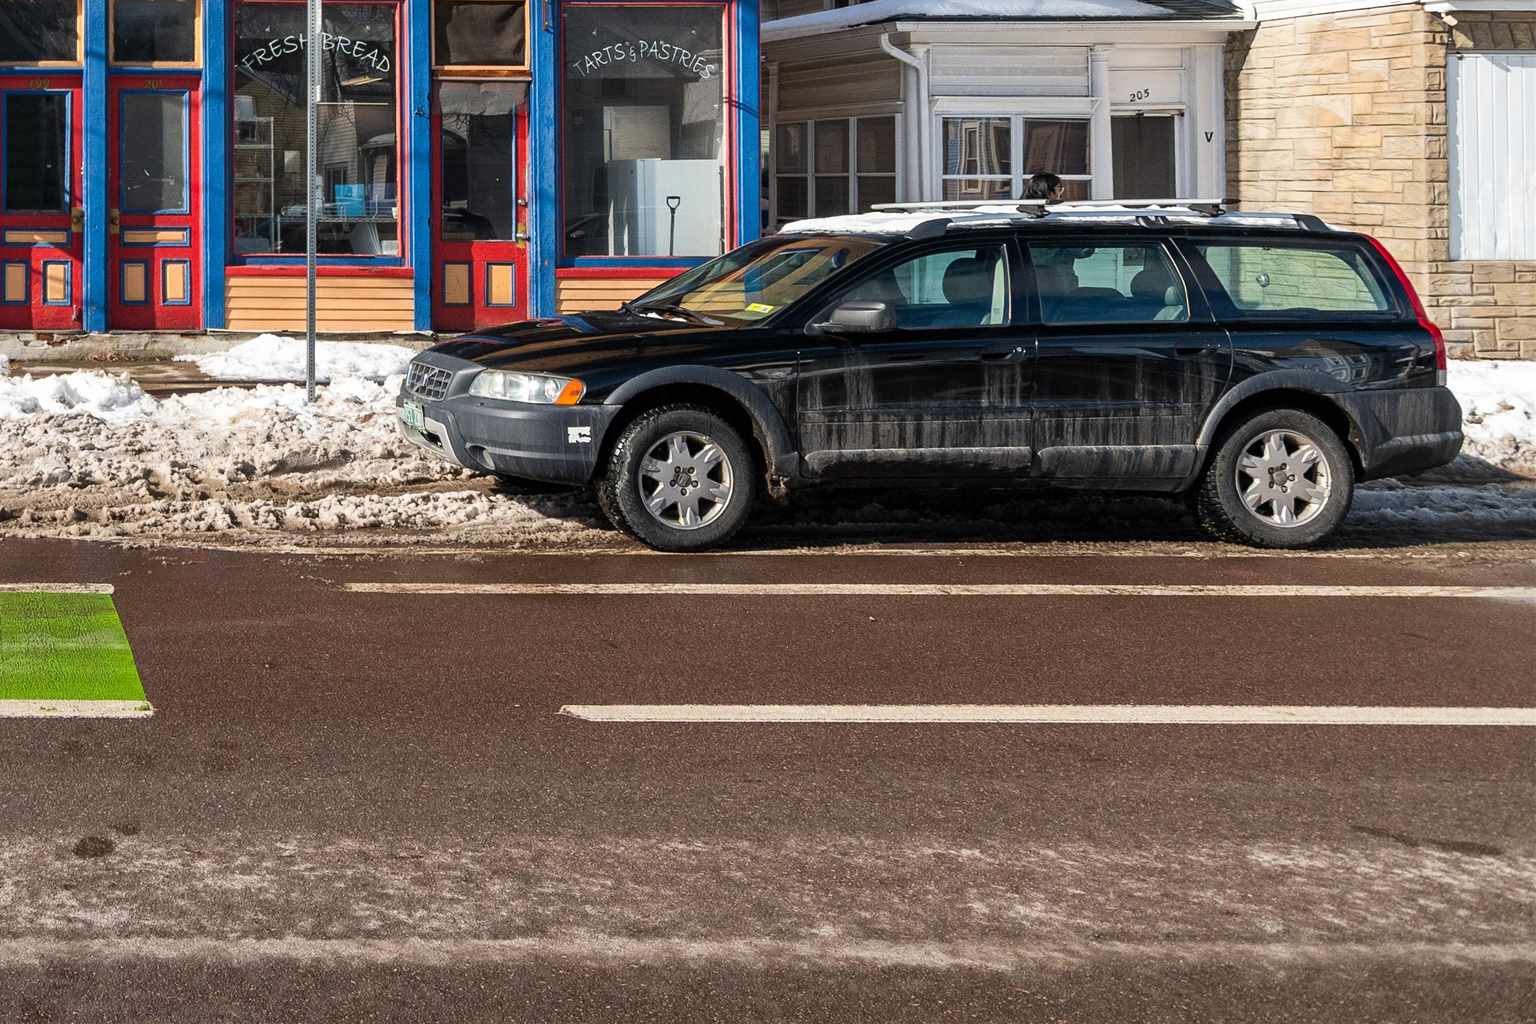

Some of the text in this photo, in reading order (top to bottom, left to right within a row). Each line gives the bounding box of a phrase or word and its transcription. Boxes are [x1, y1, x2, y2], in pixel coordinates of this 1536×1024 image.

[321, 32, 390, 72] BREAD
[573, 43, 626, 77] TARTS
[639, 40, 715, 79] PASTRIES
[1129, 88, 1150, 103] 205
